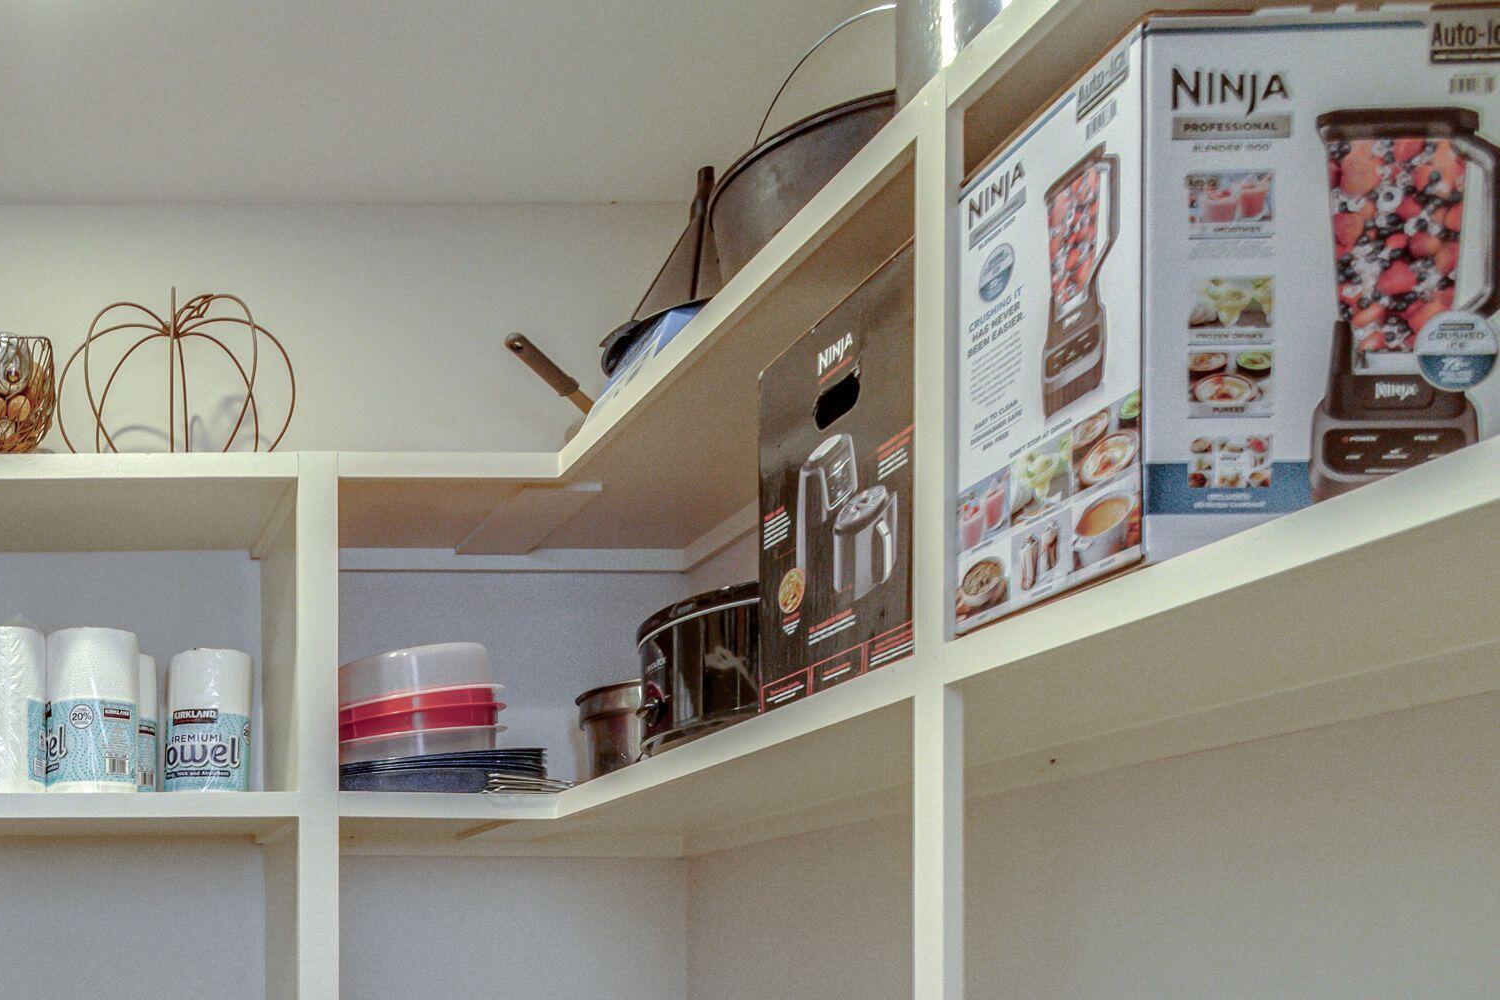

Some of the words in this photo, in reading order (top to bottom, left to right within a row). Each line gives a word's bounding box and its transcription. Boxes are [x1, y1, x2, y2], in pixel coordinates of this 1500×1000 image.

[1171, 66, 1290, 117] NINJA
[1183, 122, 1278, 132] PROFESSIONAL
[968, 160, 1027, 231] NINJA
[969, 294, 1012, 333] CRUSHING
[1014, 284, 1025, 299] IT
[972, 323, 990, 343] HAS
[991, 301, 1020, 329] NEVER
[816, 332, 853, 377] NINJA
[71, 712, 92, 721] 20%
[173, 710, 218, 719] KIRKLAND
[165, 737, 238, 767] owel
